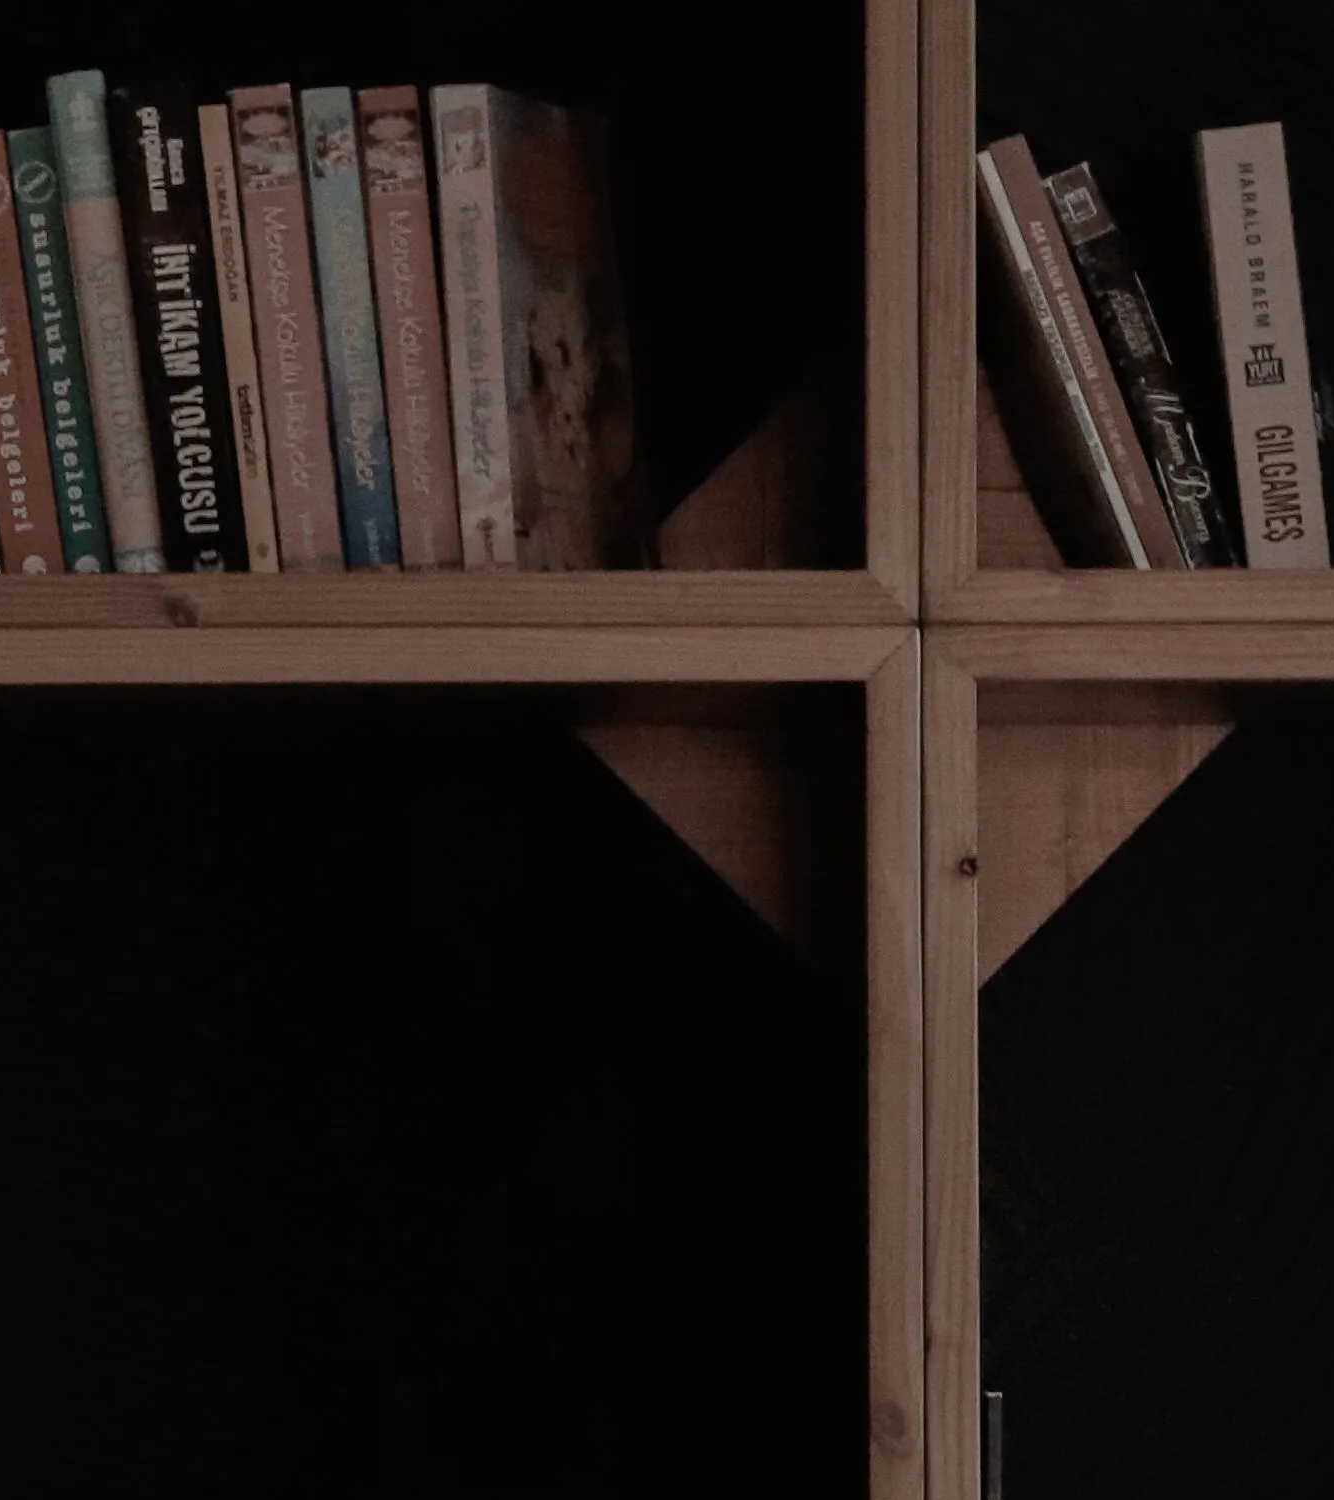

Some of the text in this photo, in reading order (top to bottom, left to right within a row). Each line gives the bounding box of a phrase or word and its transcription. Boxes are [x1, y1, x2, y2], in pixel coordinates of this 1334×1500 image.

[146, 240, 210, 380] İNTİKAM
[1236, 160, 1271, 330] HARALD BRAEM
[26, 211, 93, 533] susurluk belgeleri
[165, 384, 221, 536] YOLCUSU
[1255, 425, 1304, 542] GILGAMEŞ
